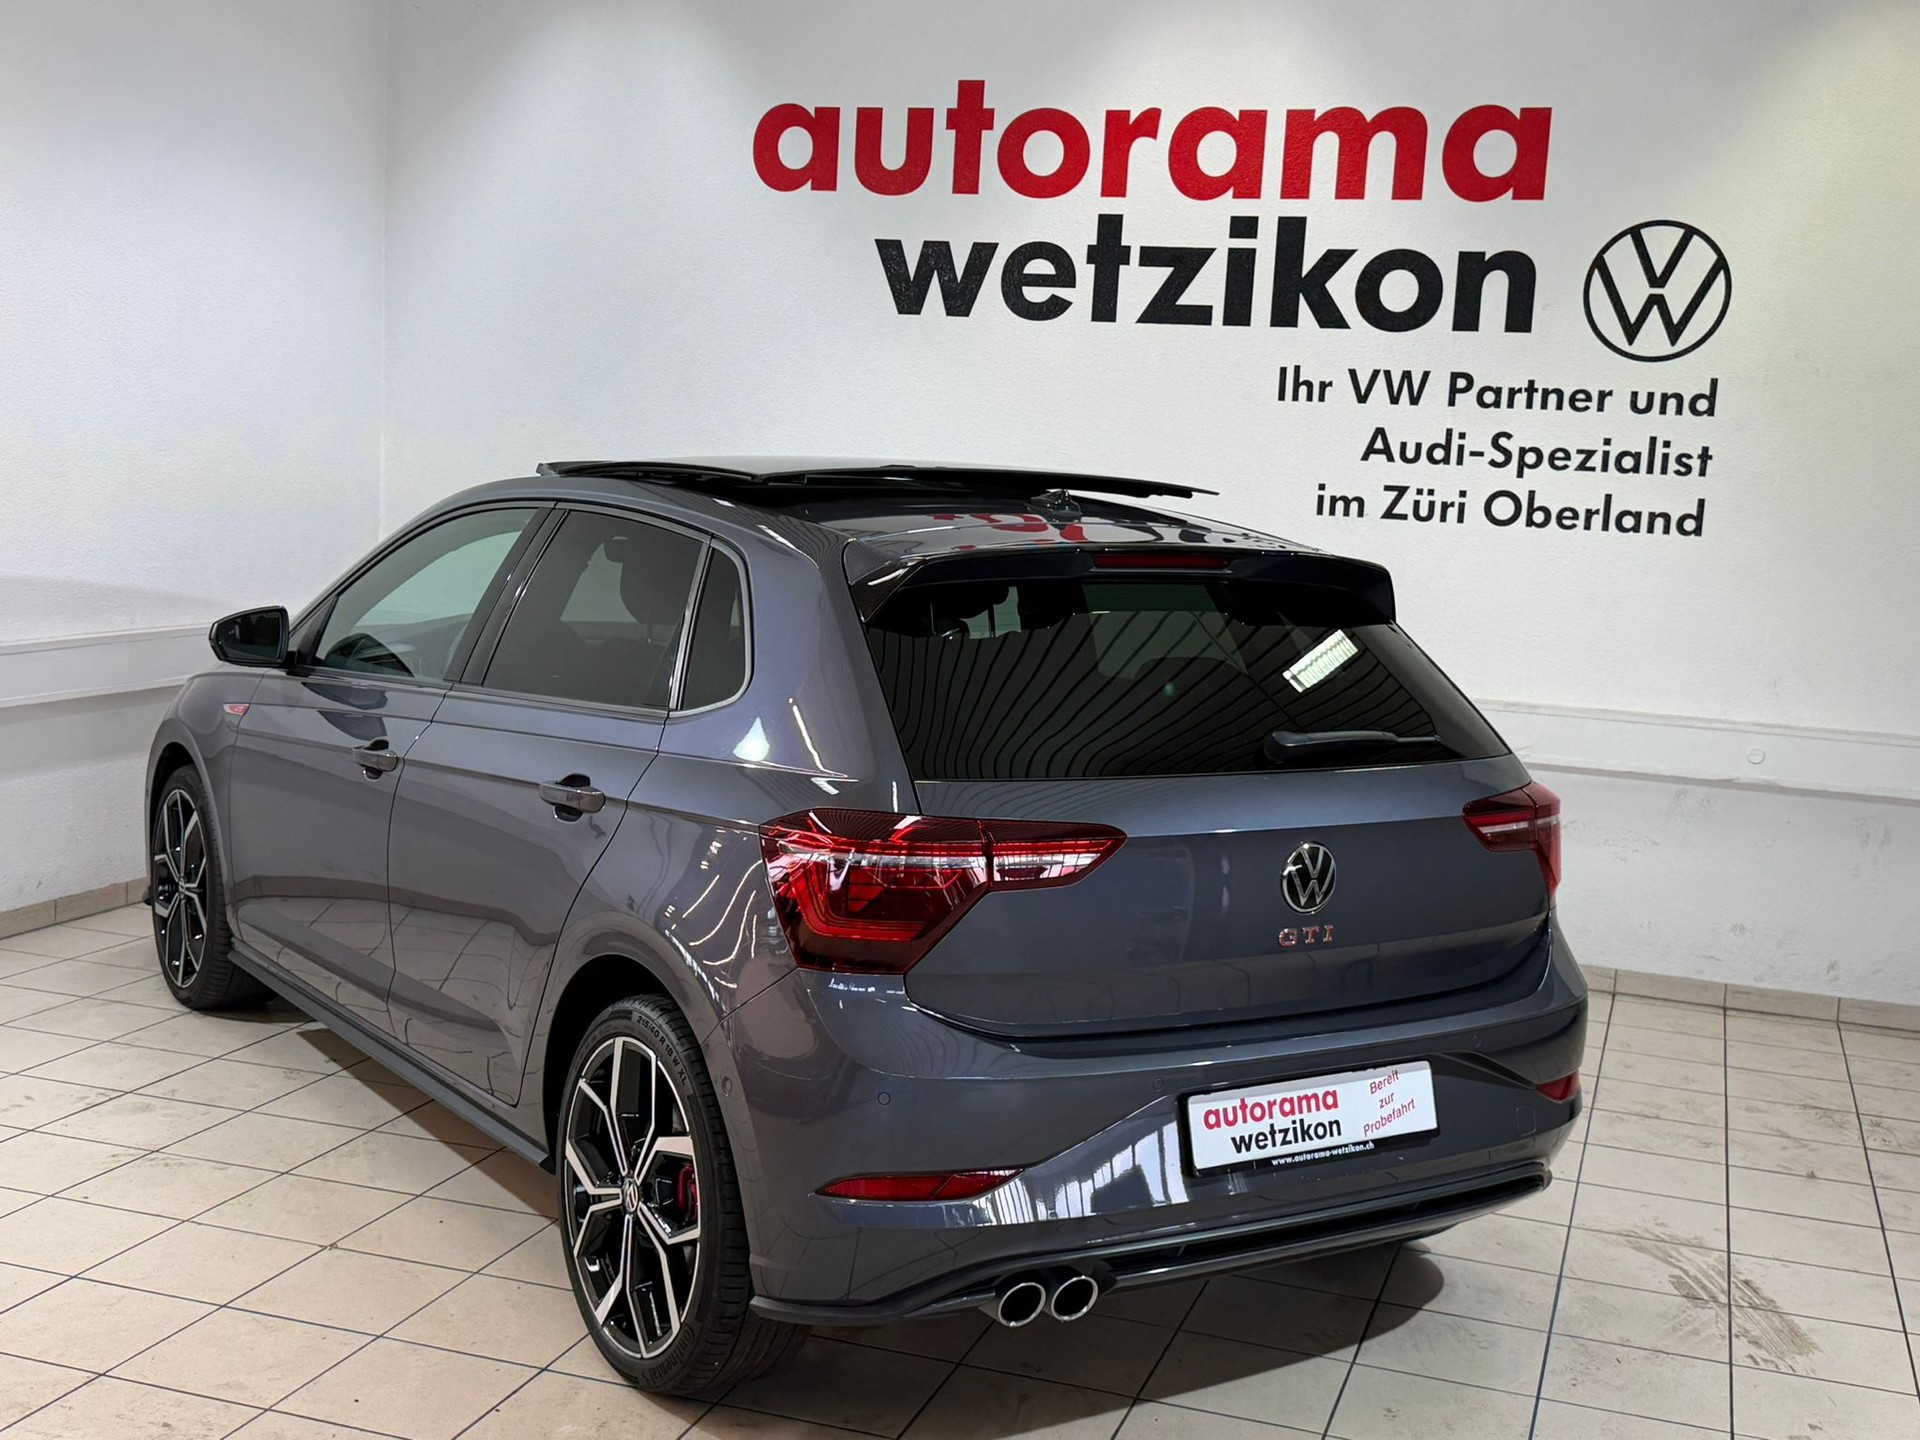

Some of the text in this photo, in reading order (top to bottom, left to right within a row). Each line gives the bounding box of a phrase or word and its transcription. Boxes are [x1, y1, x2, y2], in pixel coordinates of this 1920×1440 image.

[753, 80, 1553, 202] autorama
[875, 213, 1537, 333] wetzikon
[1277, 365, 1719, 417] Ihr VW Partner und
[1360, 427, 1714, 479] Audi-Spezialist
[1315, 483, 1706, 538] im Züri Oberland
[1278, 924, 1335, 948] GTI
[636, 1015, 660, 1038] 215/40
[1369, 1069, 1399, 1095] Bereit
[1378, 1092, 1395, 1109] zur
[1203, 1089, 1339, 1130] autorama
[1363, 1098, 1416, 1137] Probefahrt
[1230, 1118, 1342, 1154] wetzikon
[1271, 1140, 1375, 1166] www.autorama-wetzikon.ch
